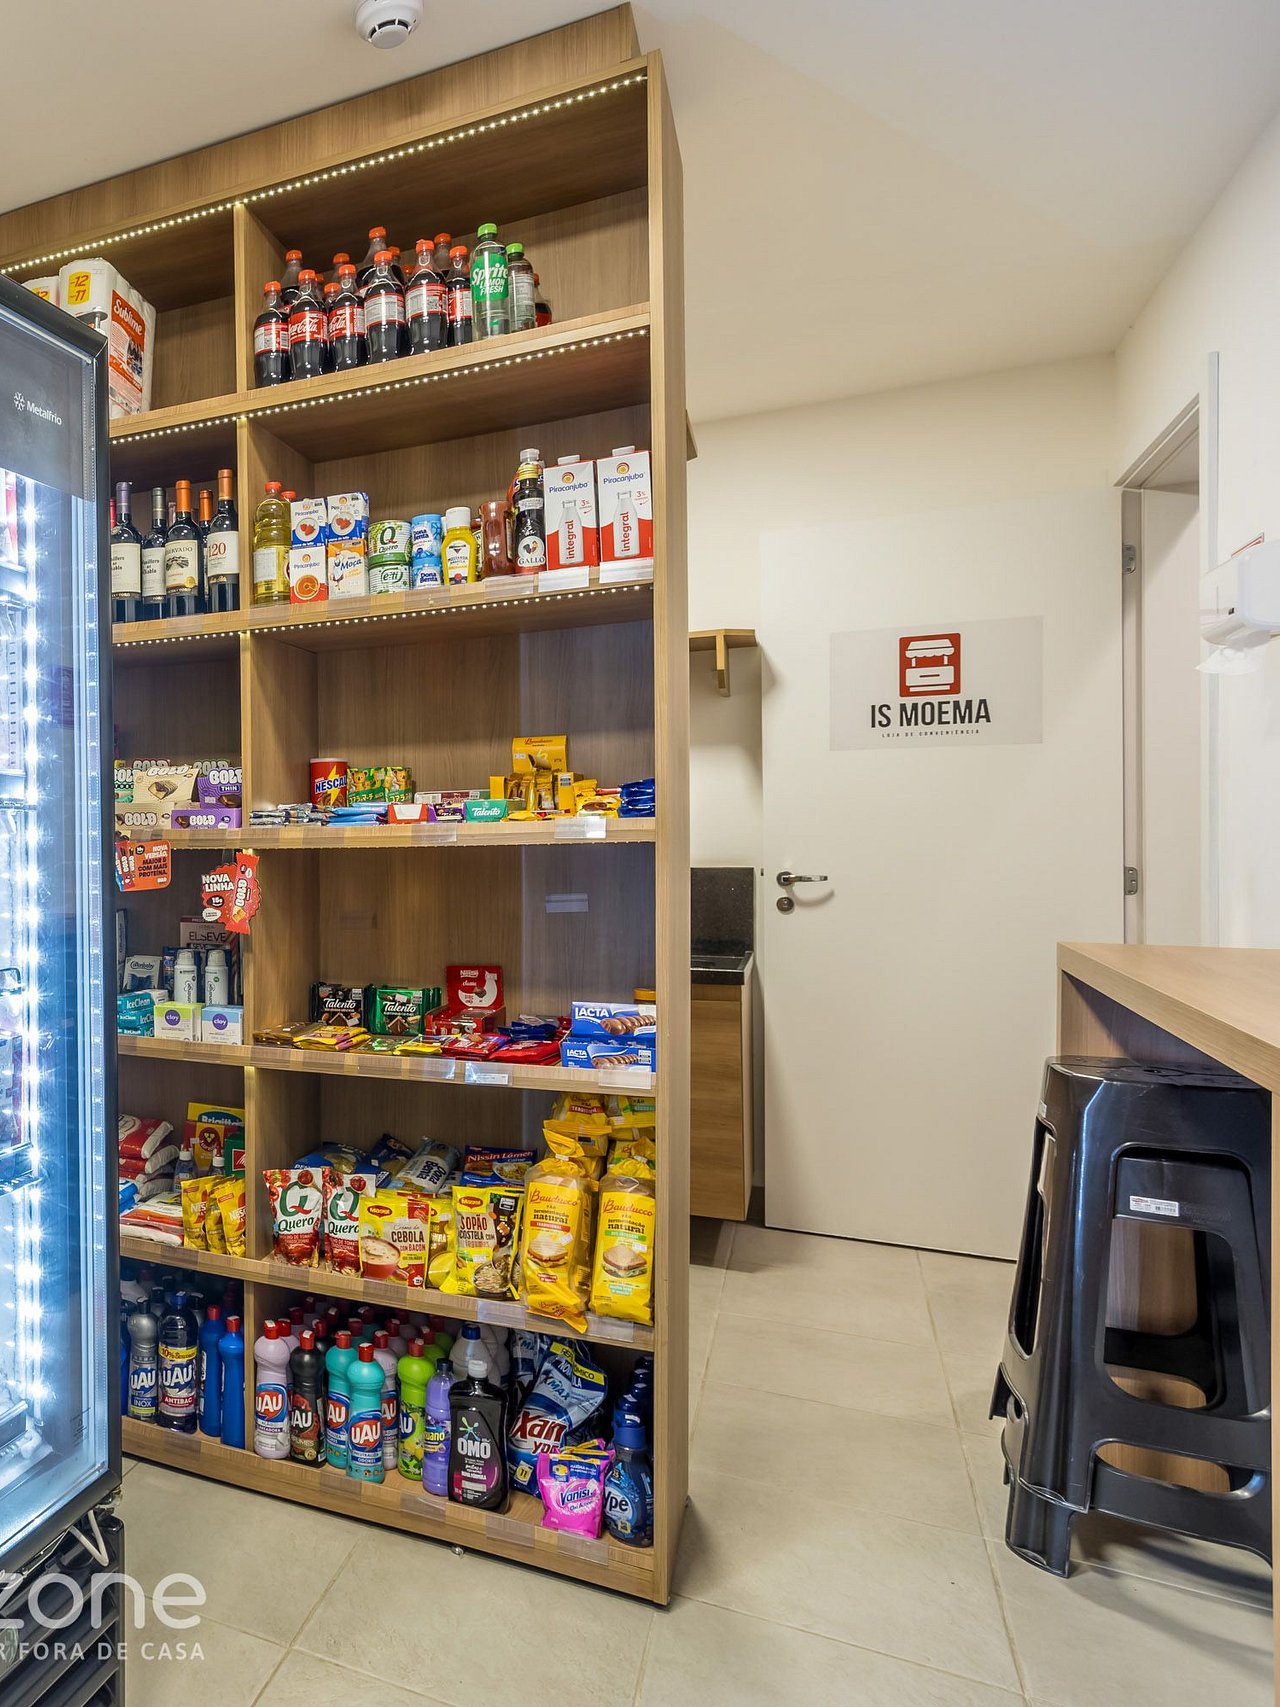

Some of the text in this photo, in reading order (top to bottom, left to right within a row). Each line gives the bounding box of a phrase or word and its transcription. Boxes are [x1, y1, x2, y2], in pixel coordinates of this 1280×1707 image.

[472, 263, 509, 286] Sprite
[481, 279, 505, 289] LMON
[480, 286, 504, 296] FESH
[113, 299, 144, 336] Sublime
[26, 402, 63, 426] Metalfrio
[603, 471, 645, 485] Piracanjuba
[549, 481, 589, 494] Piracanjuba
[621, 511, 632, 552] integral
[566, 519, 577, 560] integral
[378, 544, 399, 553] Quero
[340, 558, 363, 571] Moça
[518, 557, 546, 565] GALLO
[871, 699, 992, 728] IS MOEMA
[919, 729, 980, 737] CONVENIÊNCIA
[315, 775, 348, 793] NESCAU
[471, 806, 501, 817] Talento
[124, 812, 158, 827] BOLD
[189, 814, 216, 826] BOLD
[152, 845, 168, 853] NOVA
[201, 873, 231, 885] NOVA
[205, 882, 235, 892] LINHA
[126, 998, 151, 1010] IceClean
[323, 998, 357, 1010] Talento
[382, 1001, 418, 1013] Talento
[575, 1007, 609, 1019] LACTA
[567, 1049, 588, 1057] LACTA
[467, 1152, 500, 1162] Nissin
[529, 1188, 579, 1207] Bauducco
[603, 1199, 654, 1217] Bauducco
[278, 1216, 315, 1232] Quero
[460, 1214, 489, 1231] SOPÃO
[533, 1213, 569, 1224] natural
[328, 1221, 360, 1236] Quero
[607, 1223, 646, 1235] natural
[408, 1243, 426, 1252] BACON
[131, 1370, 156, 1390] UAU
[162, 1364, 192, 1387] UAU
[133, 1399, 152, 1407] INOX
[164, 1397, 192, 1405] ANTIBAC
[255, 1393, 283, 1413] UAU
[327, 1403, 346, 1423] AU
[381, 1400, 397, 1420] AU
[351, 1421, 381, 1445] UAU
[457, 1437, 491, 1459] OMO
